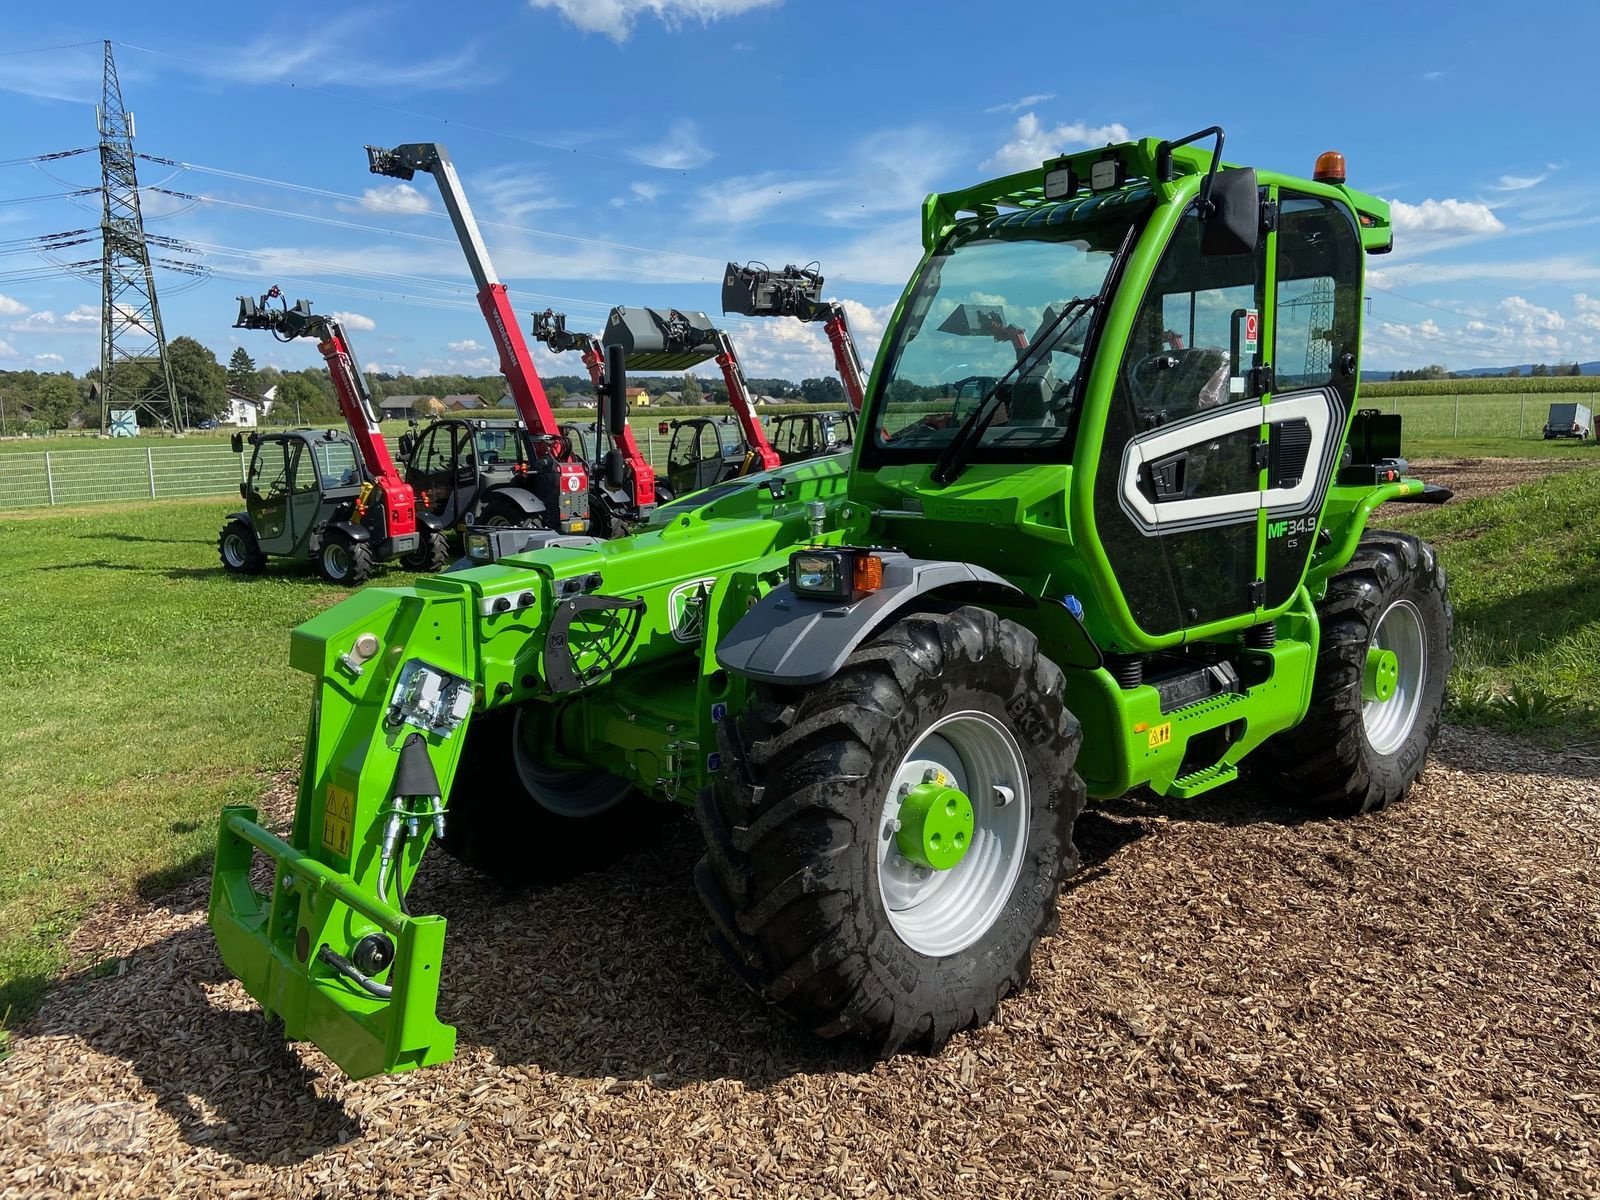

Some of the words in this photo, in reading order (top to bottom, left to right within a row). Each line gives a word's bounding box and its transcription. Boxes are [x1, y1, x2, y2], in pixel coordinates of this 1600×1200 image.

[492, 307, 518, 367] WEIDEMANN
[1287, 539, 1298, 548] CS
[1010, 695, 1047, 740] BKT
